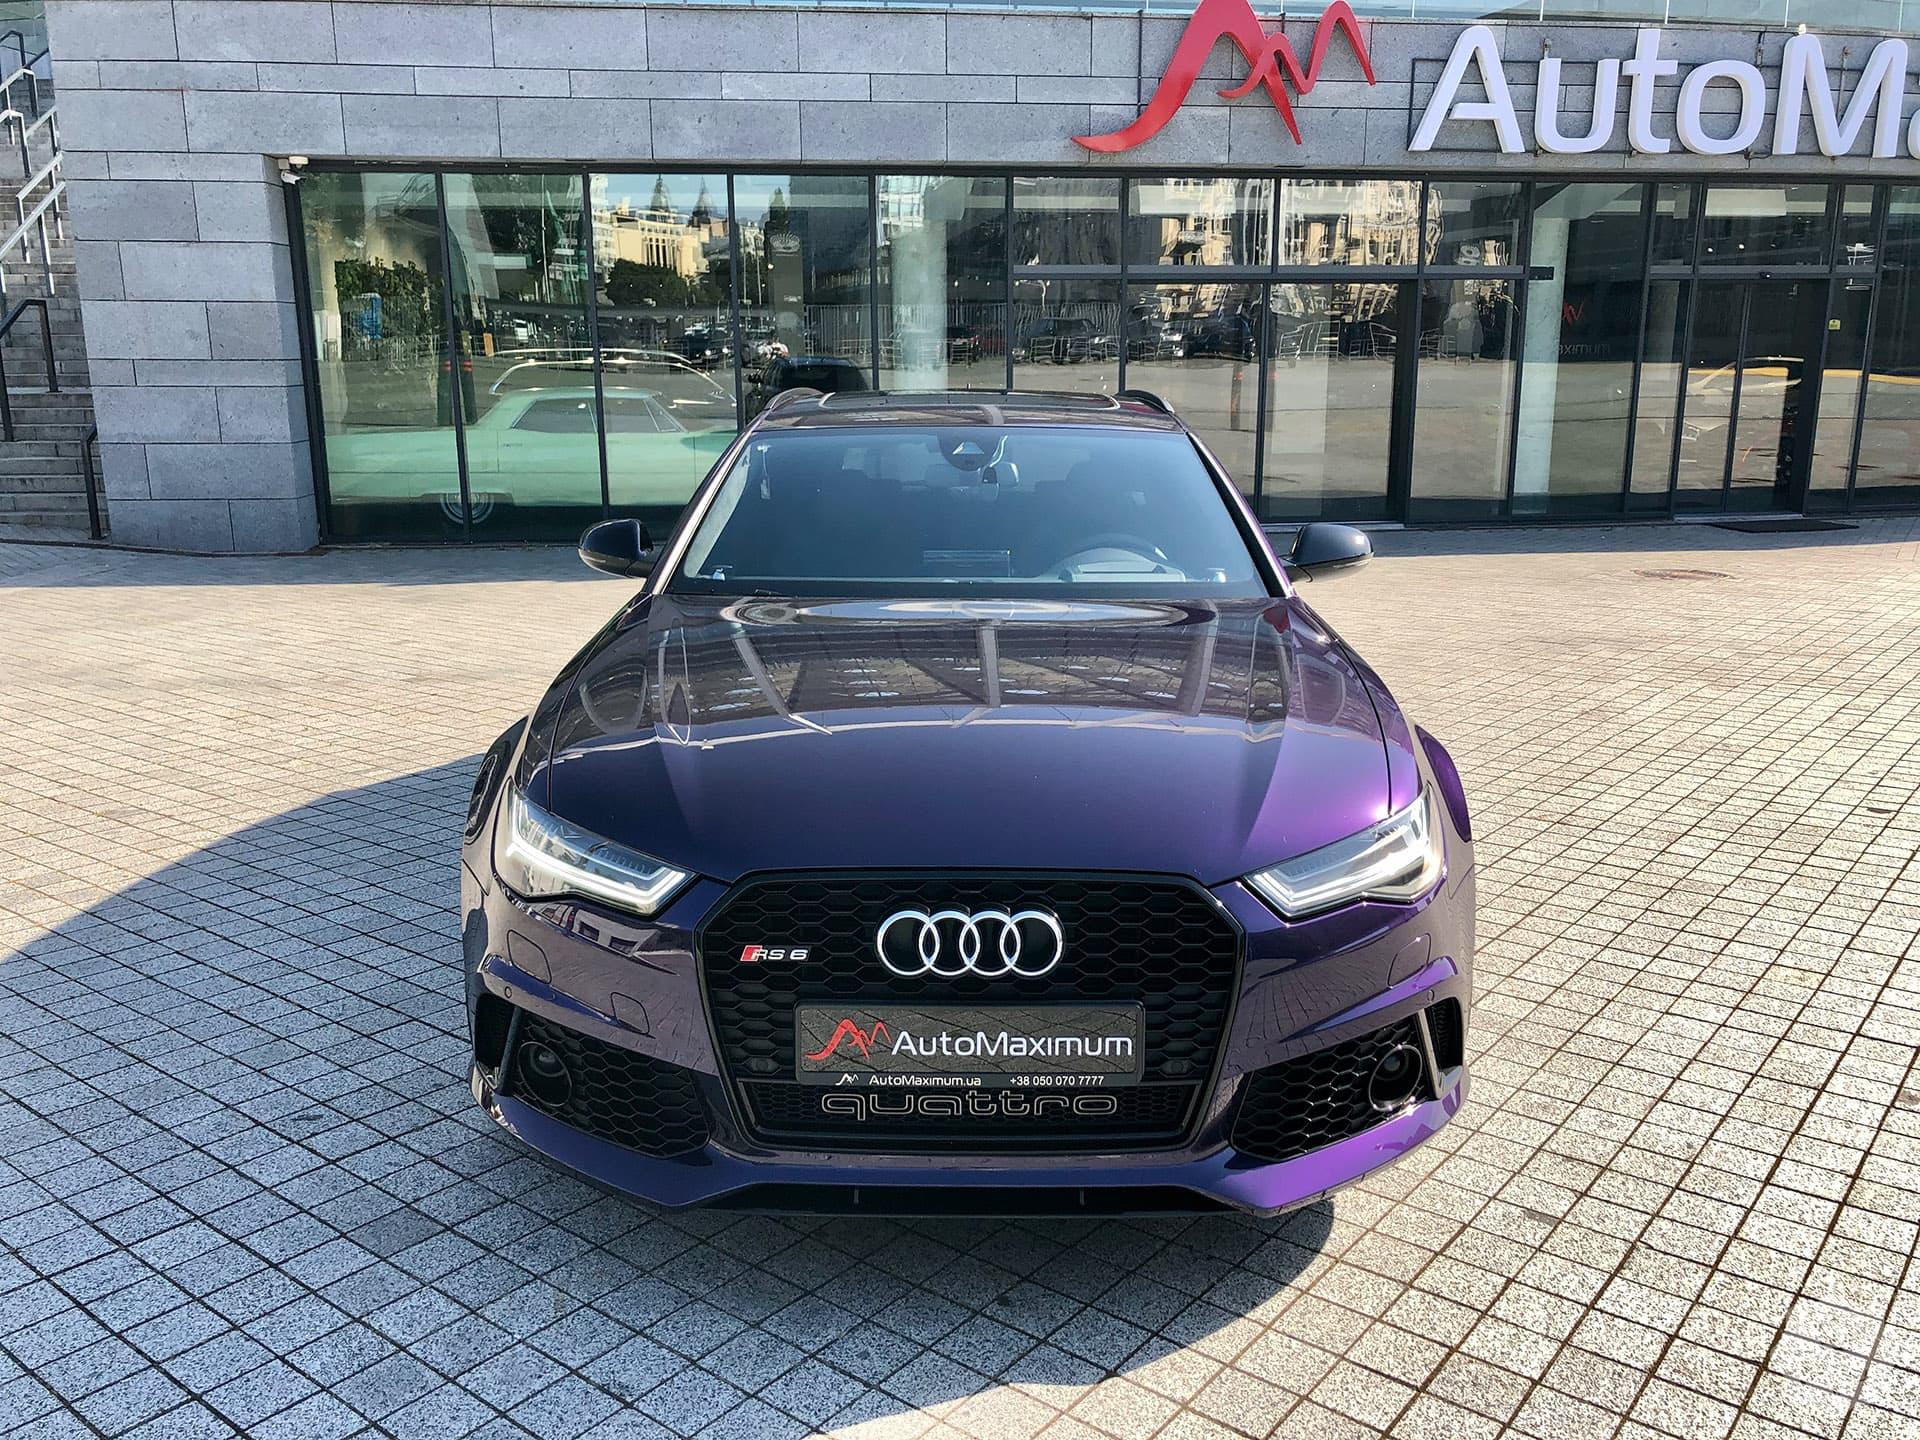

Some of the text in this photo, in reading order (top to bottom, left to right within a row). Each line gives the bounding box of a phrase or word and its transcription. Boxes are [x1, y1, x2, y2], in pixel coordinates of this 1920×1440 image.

[1408, 25, 1920, 159] AutoM
[744, 947, 809, 960] RS 6
[891, 1031, 1133, 1056] AutoMaximum
[869, 1075, 1104, 1086] AutoMaximum.ua +38 050 070 7777
[821, 1090, 1118, 1121] quattro
